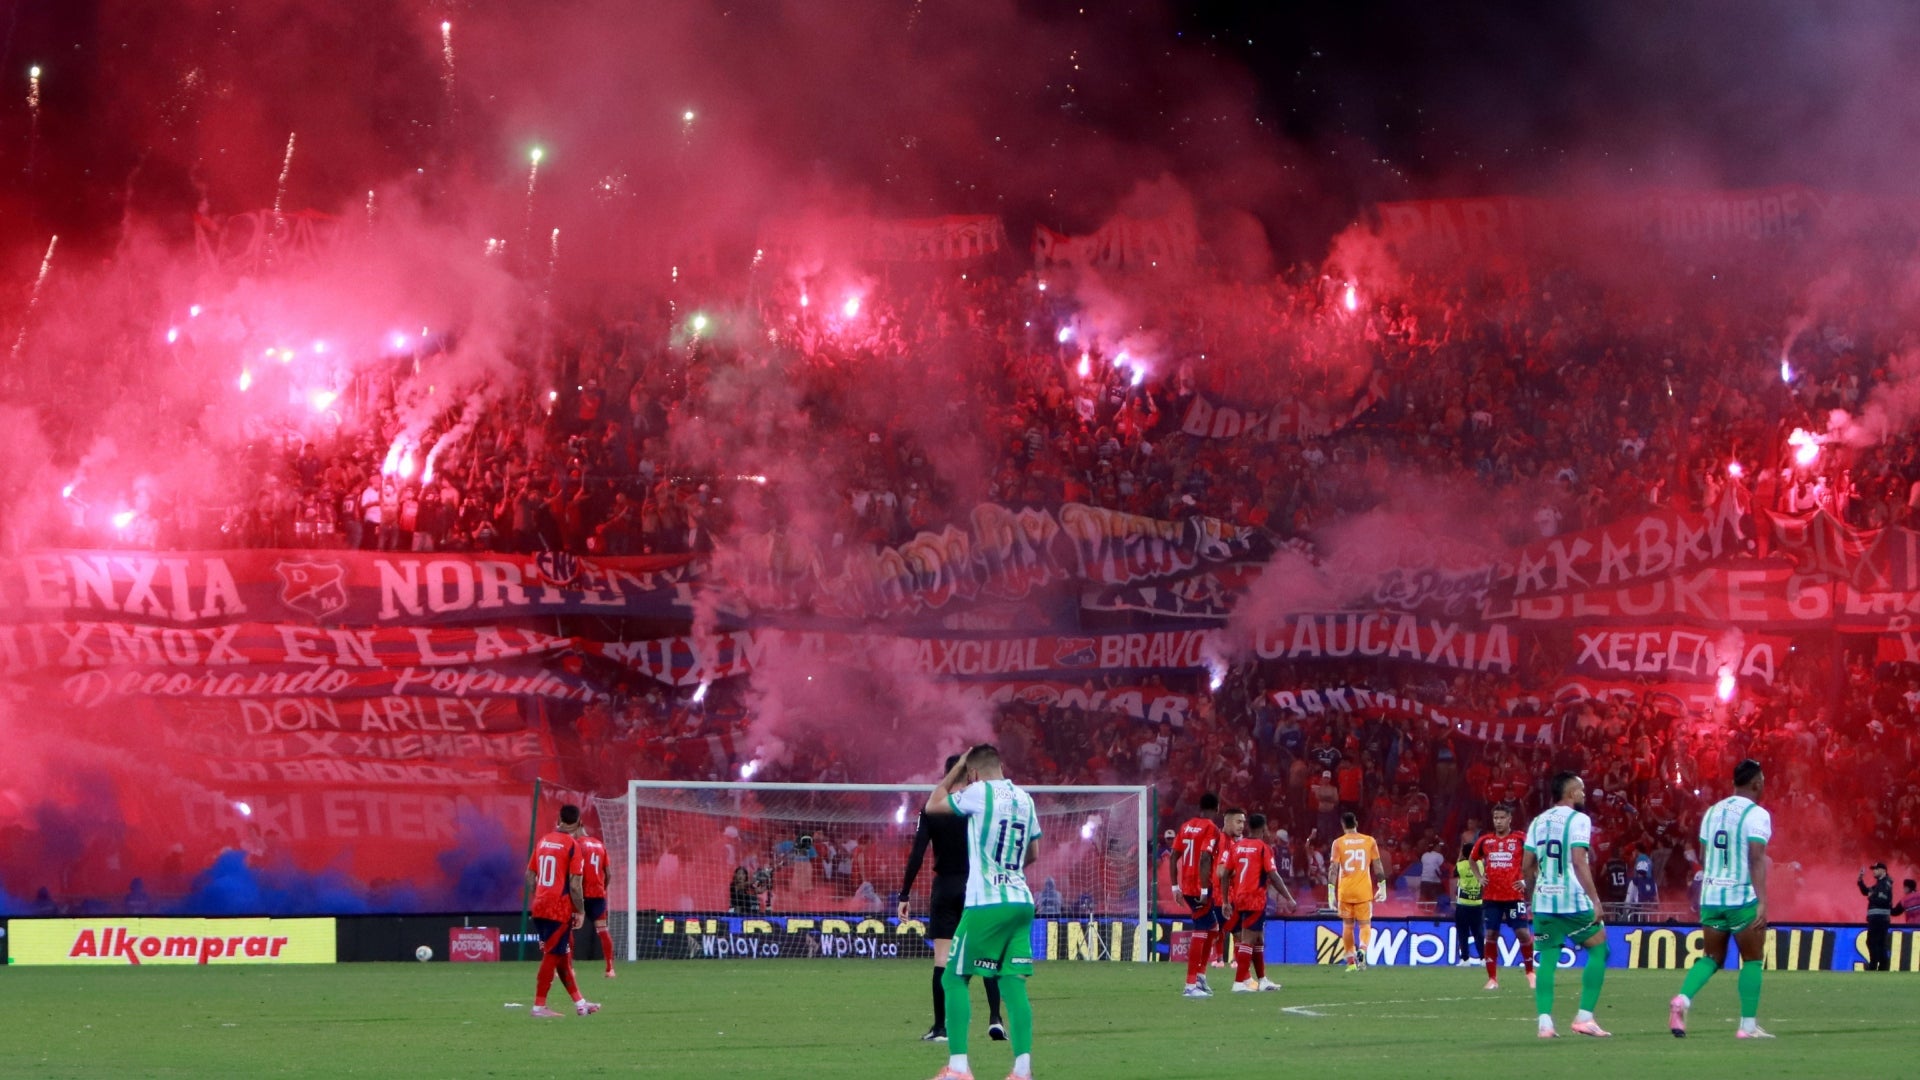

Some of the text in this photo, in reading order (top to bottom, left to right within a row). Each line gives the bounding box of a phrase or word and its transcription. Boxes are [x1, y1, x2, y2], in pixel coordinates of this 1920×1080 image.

[0, 554, 248, 622] ENXIA
[1787, 573, 1829, 619] 6
[275, 625, 384, 667] EN
[1254, 613, 1513, 677] CAUCAXIA
[241, 696, 493, 735] DON ARLEY
[994, 819, 1024, 870] 13
[1181, 838, 1195, 867] 71
[1344, 848, 1367, 872] 29
[1713, 829, 1729, 868] 9
[538, 854, 557, 888] 10
[591, 852, 600, 875] 4
[1239, 857, 1249, 884] 7
[1611, 872, 1626, 886] 15
[1517, 902, 1527, 914] 15
[69, 927, 288, 965] Alkomprar
[702, 933, 780, 959] Wplay.co
[820, 933, 898, 959] Wplay.co
[1366, 926, 1577, 967] Wply.o
